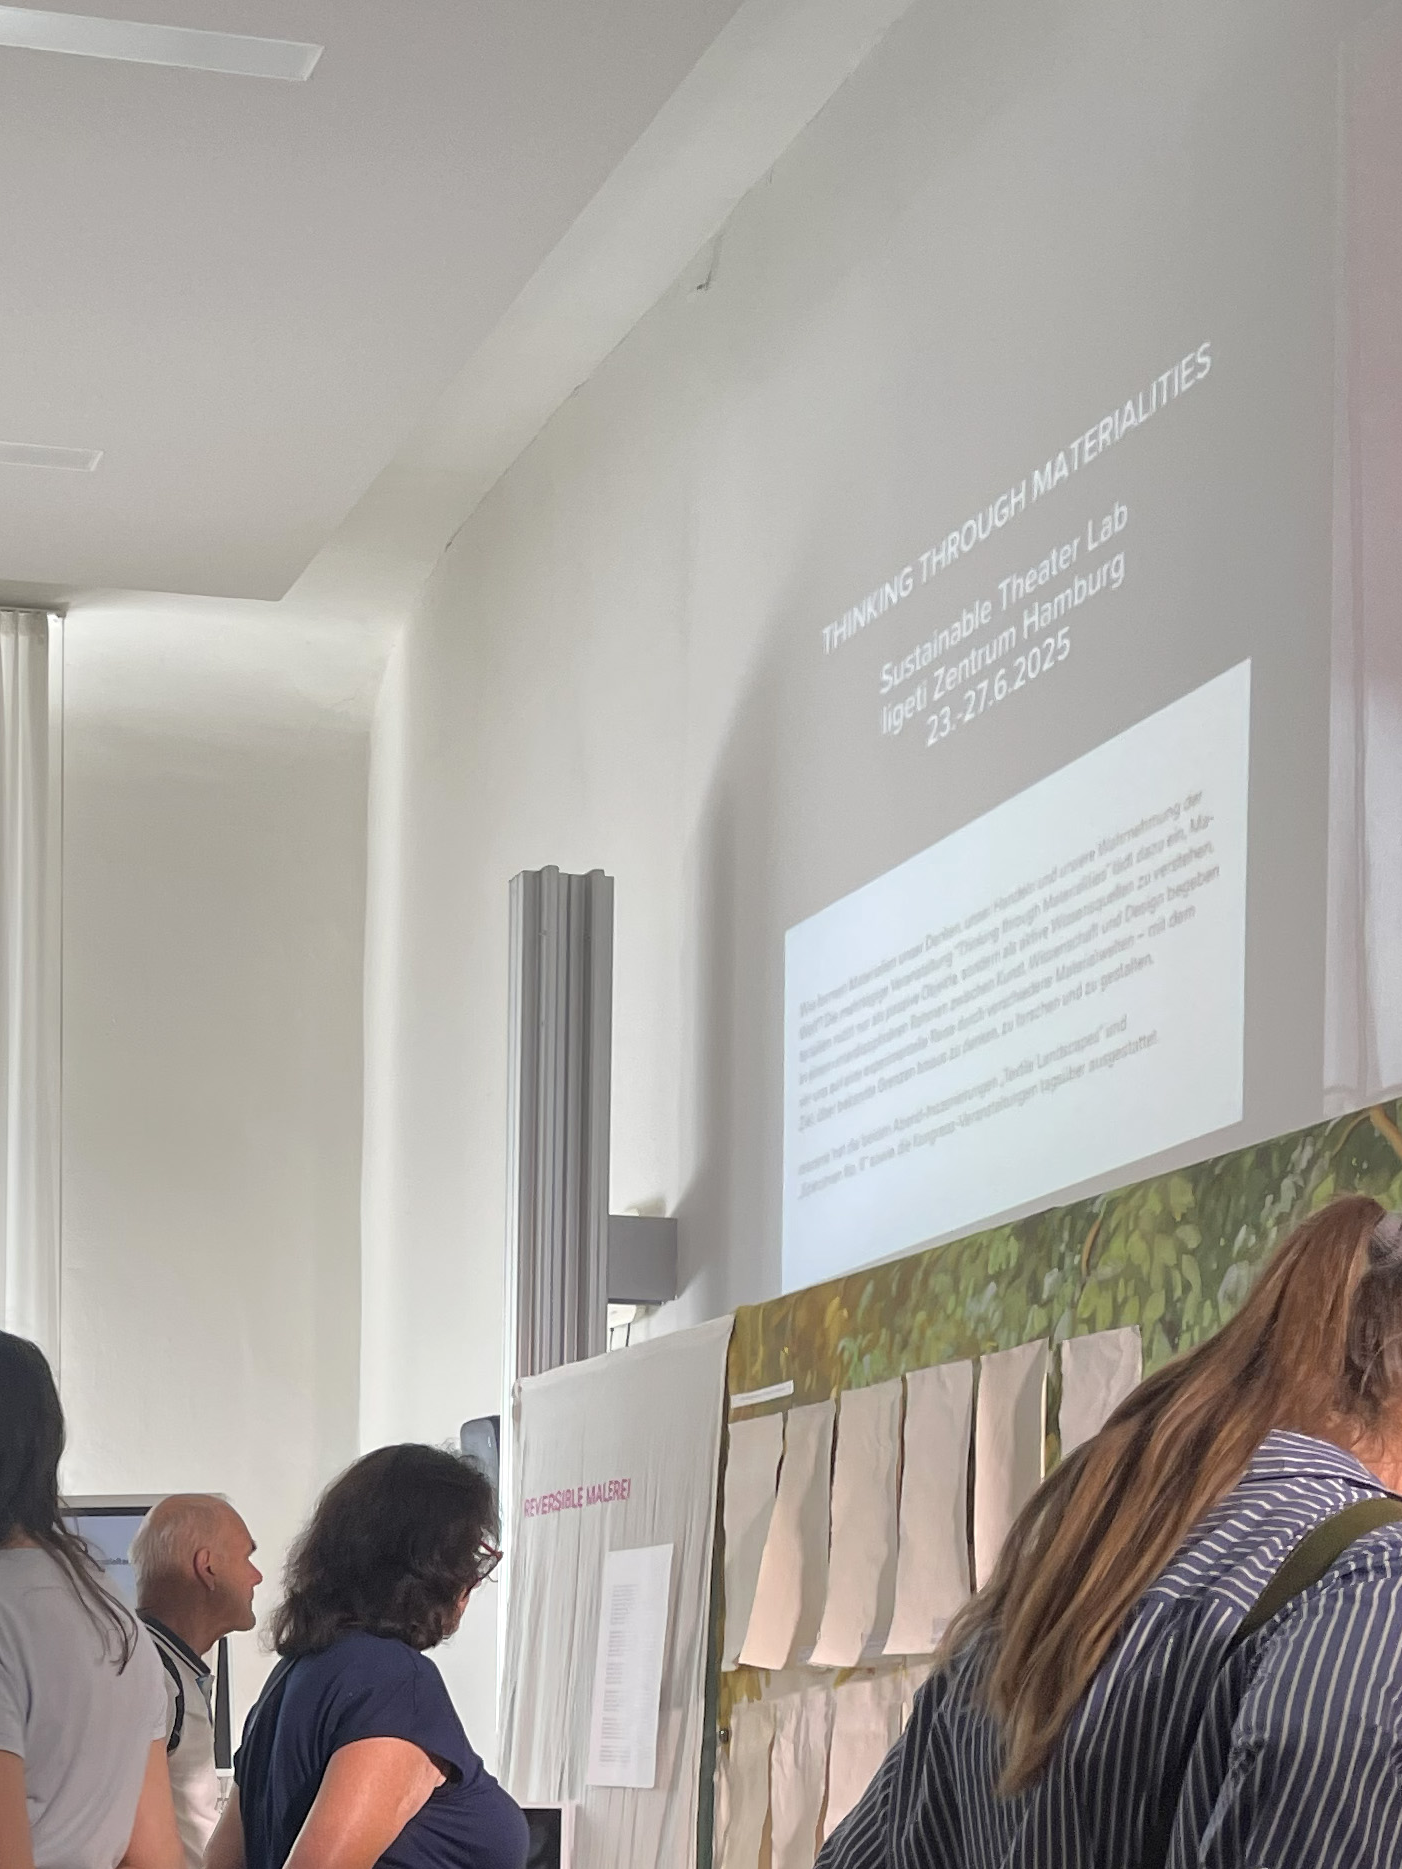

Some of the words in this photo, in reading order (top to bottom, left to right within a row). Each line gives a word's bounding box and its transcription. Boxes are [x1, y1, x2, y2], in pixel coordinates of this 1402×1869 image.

[821, 565, 915, 656] THINKING
[918, 478, 1027, 584] THROUGH
[1031, 341, 1212, 503] MATERIALITIES
[879, 599, 993, 695] Sustainable
[998, 534, 1081, 613] Theater
[1087, 500, 1129, 552] Lab
[882, 678, 928, 737] ligeti
[932, 624, 1017, 702] Zentrum
[1022, 550, 1126, 640] Hamburg
[922, 624, 1071, 748] 23.-27.6.2025
[524, 1486, 583, 1517] REVERSIBLE
[586, 1478, 631, 1506] MALEREI
